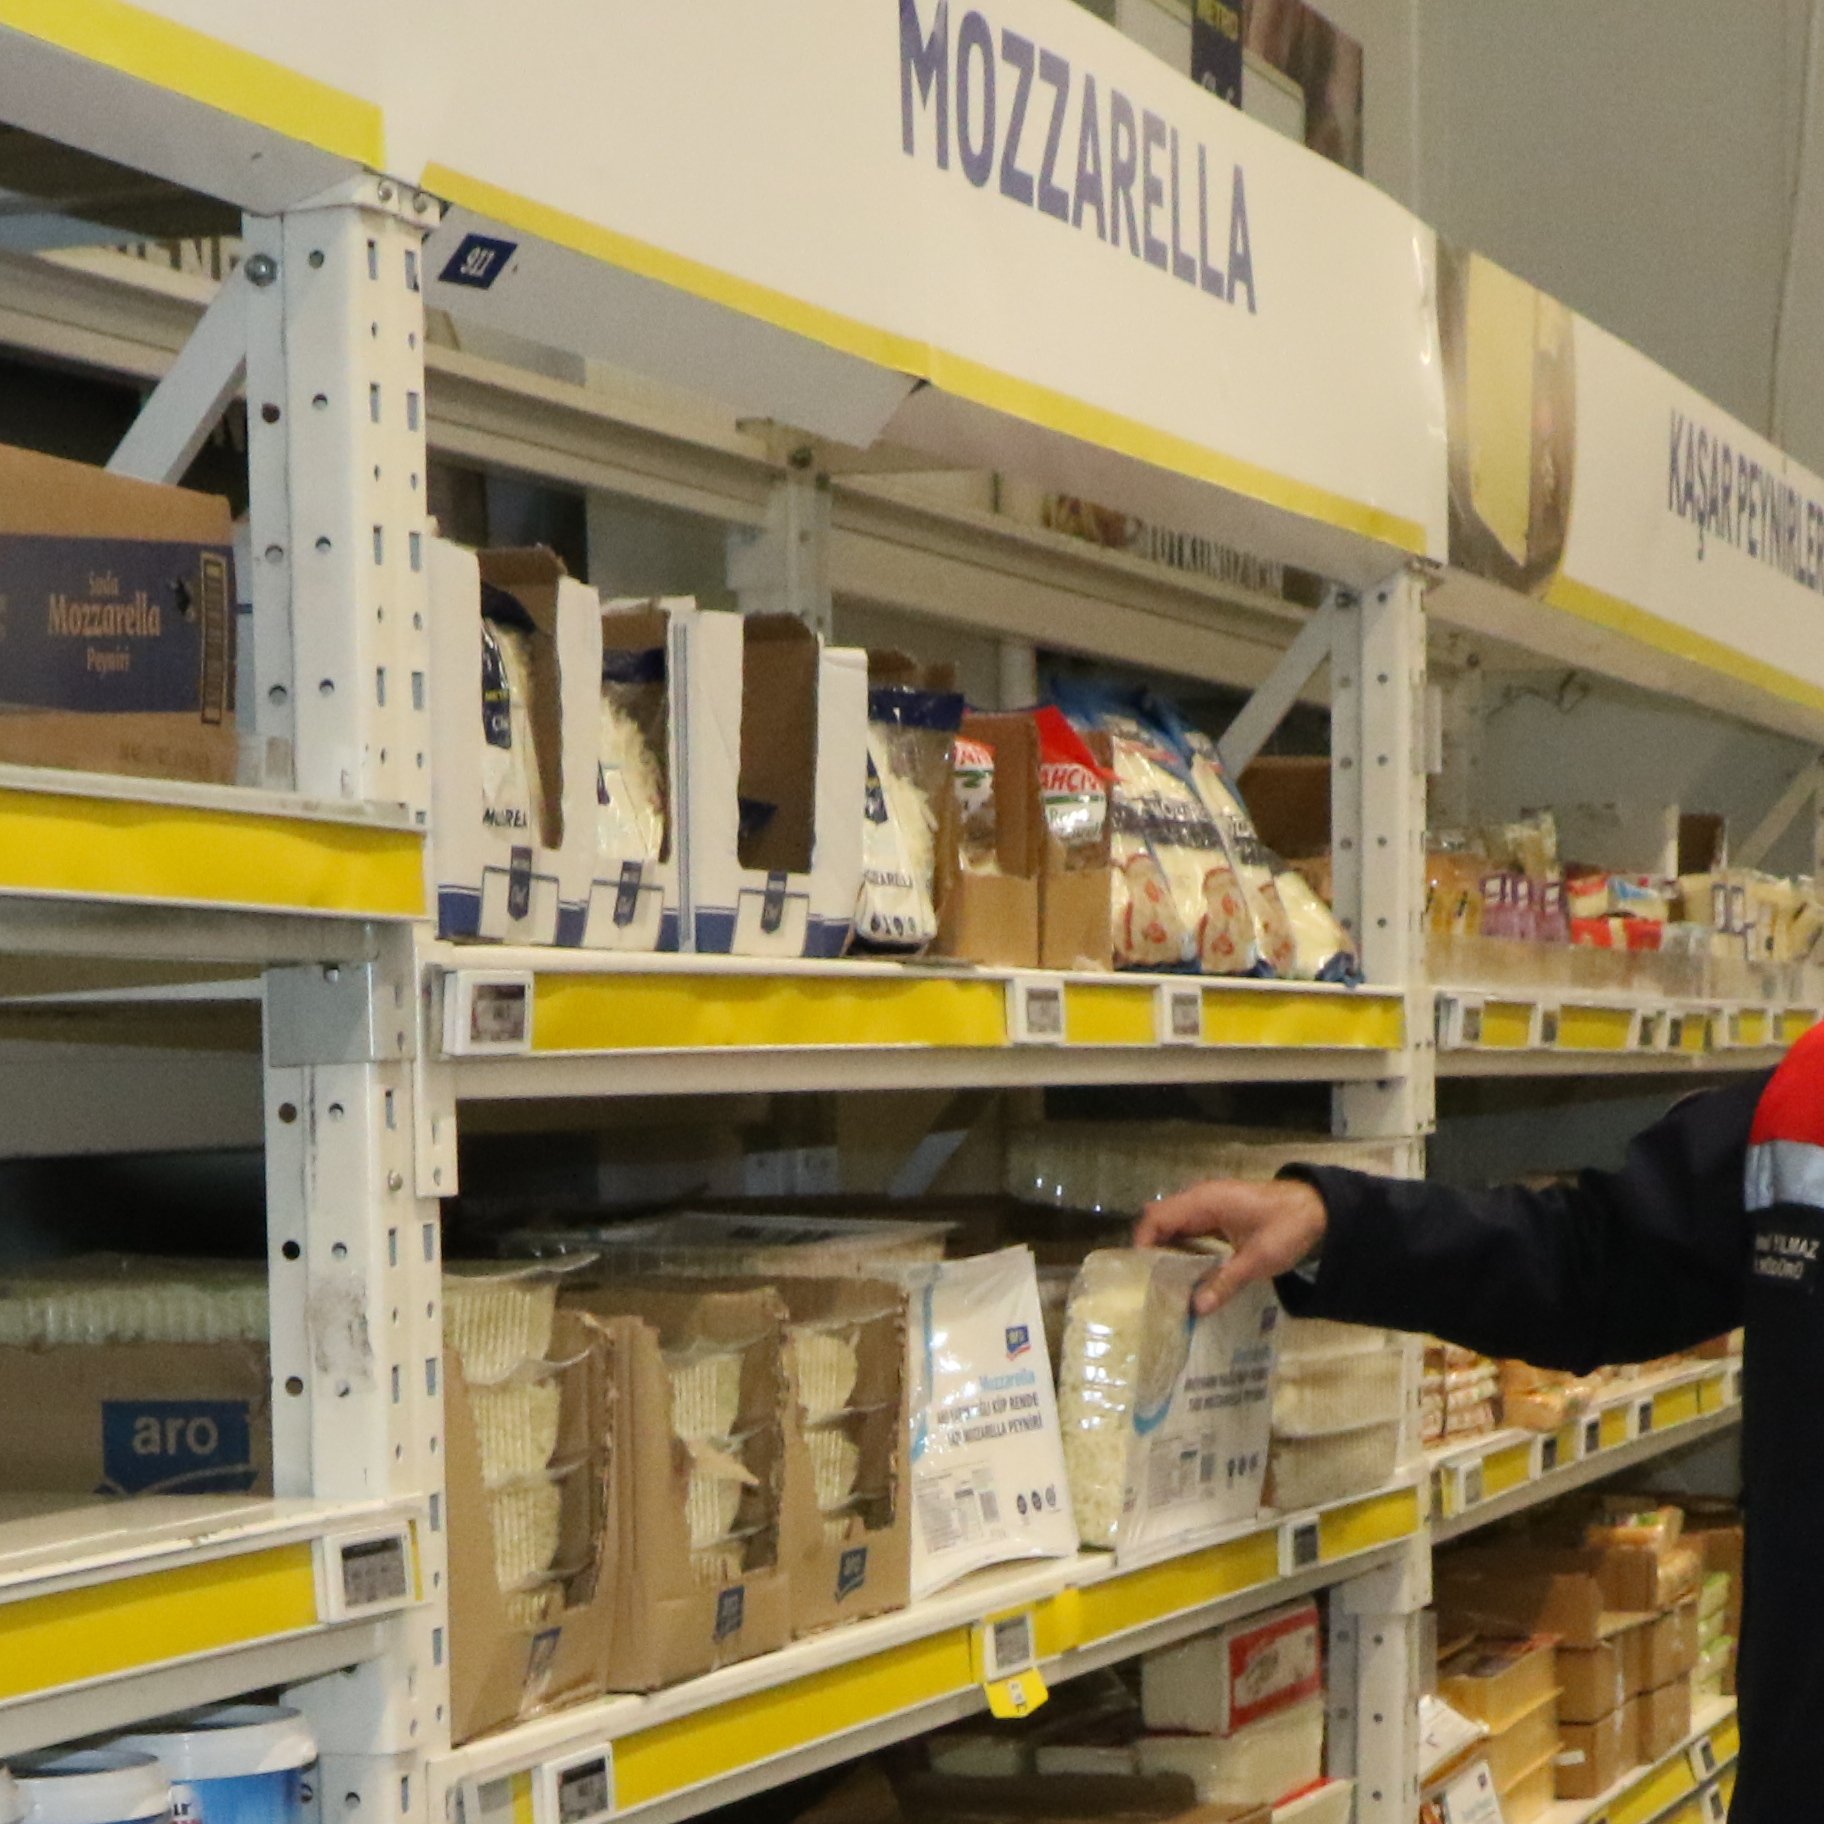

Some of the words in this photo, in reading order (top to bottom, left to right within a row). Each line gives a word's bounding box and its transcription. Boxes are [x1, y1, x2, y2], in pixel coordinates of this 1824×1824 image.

[899, 0, 1258, 314] MOZZARELLA
[1670, 406, 1732, 561] KAŞAR
[48, 596, 161, 639] Mozzarella
[132, 1411, 219, 1459] aro
